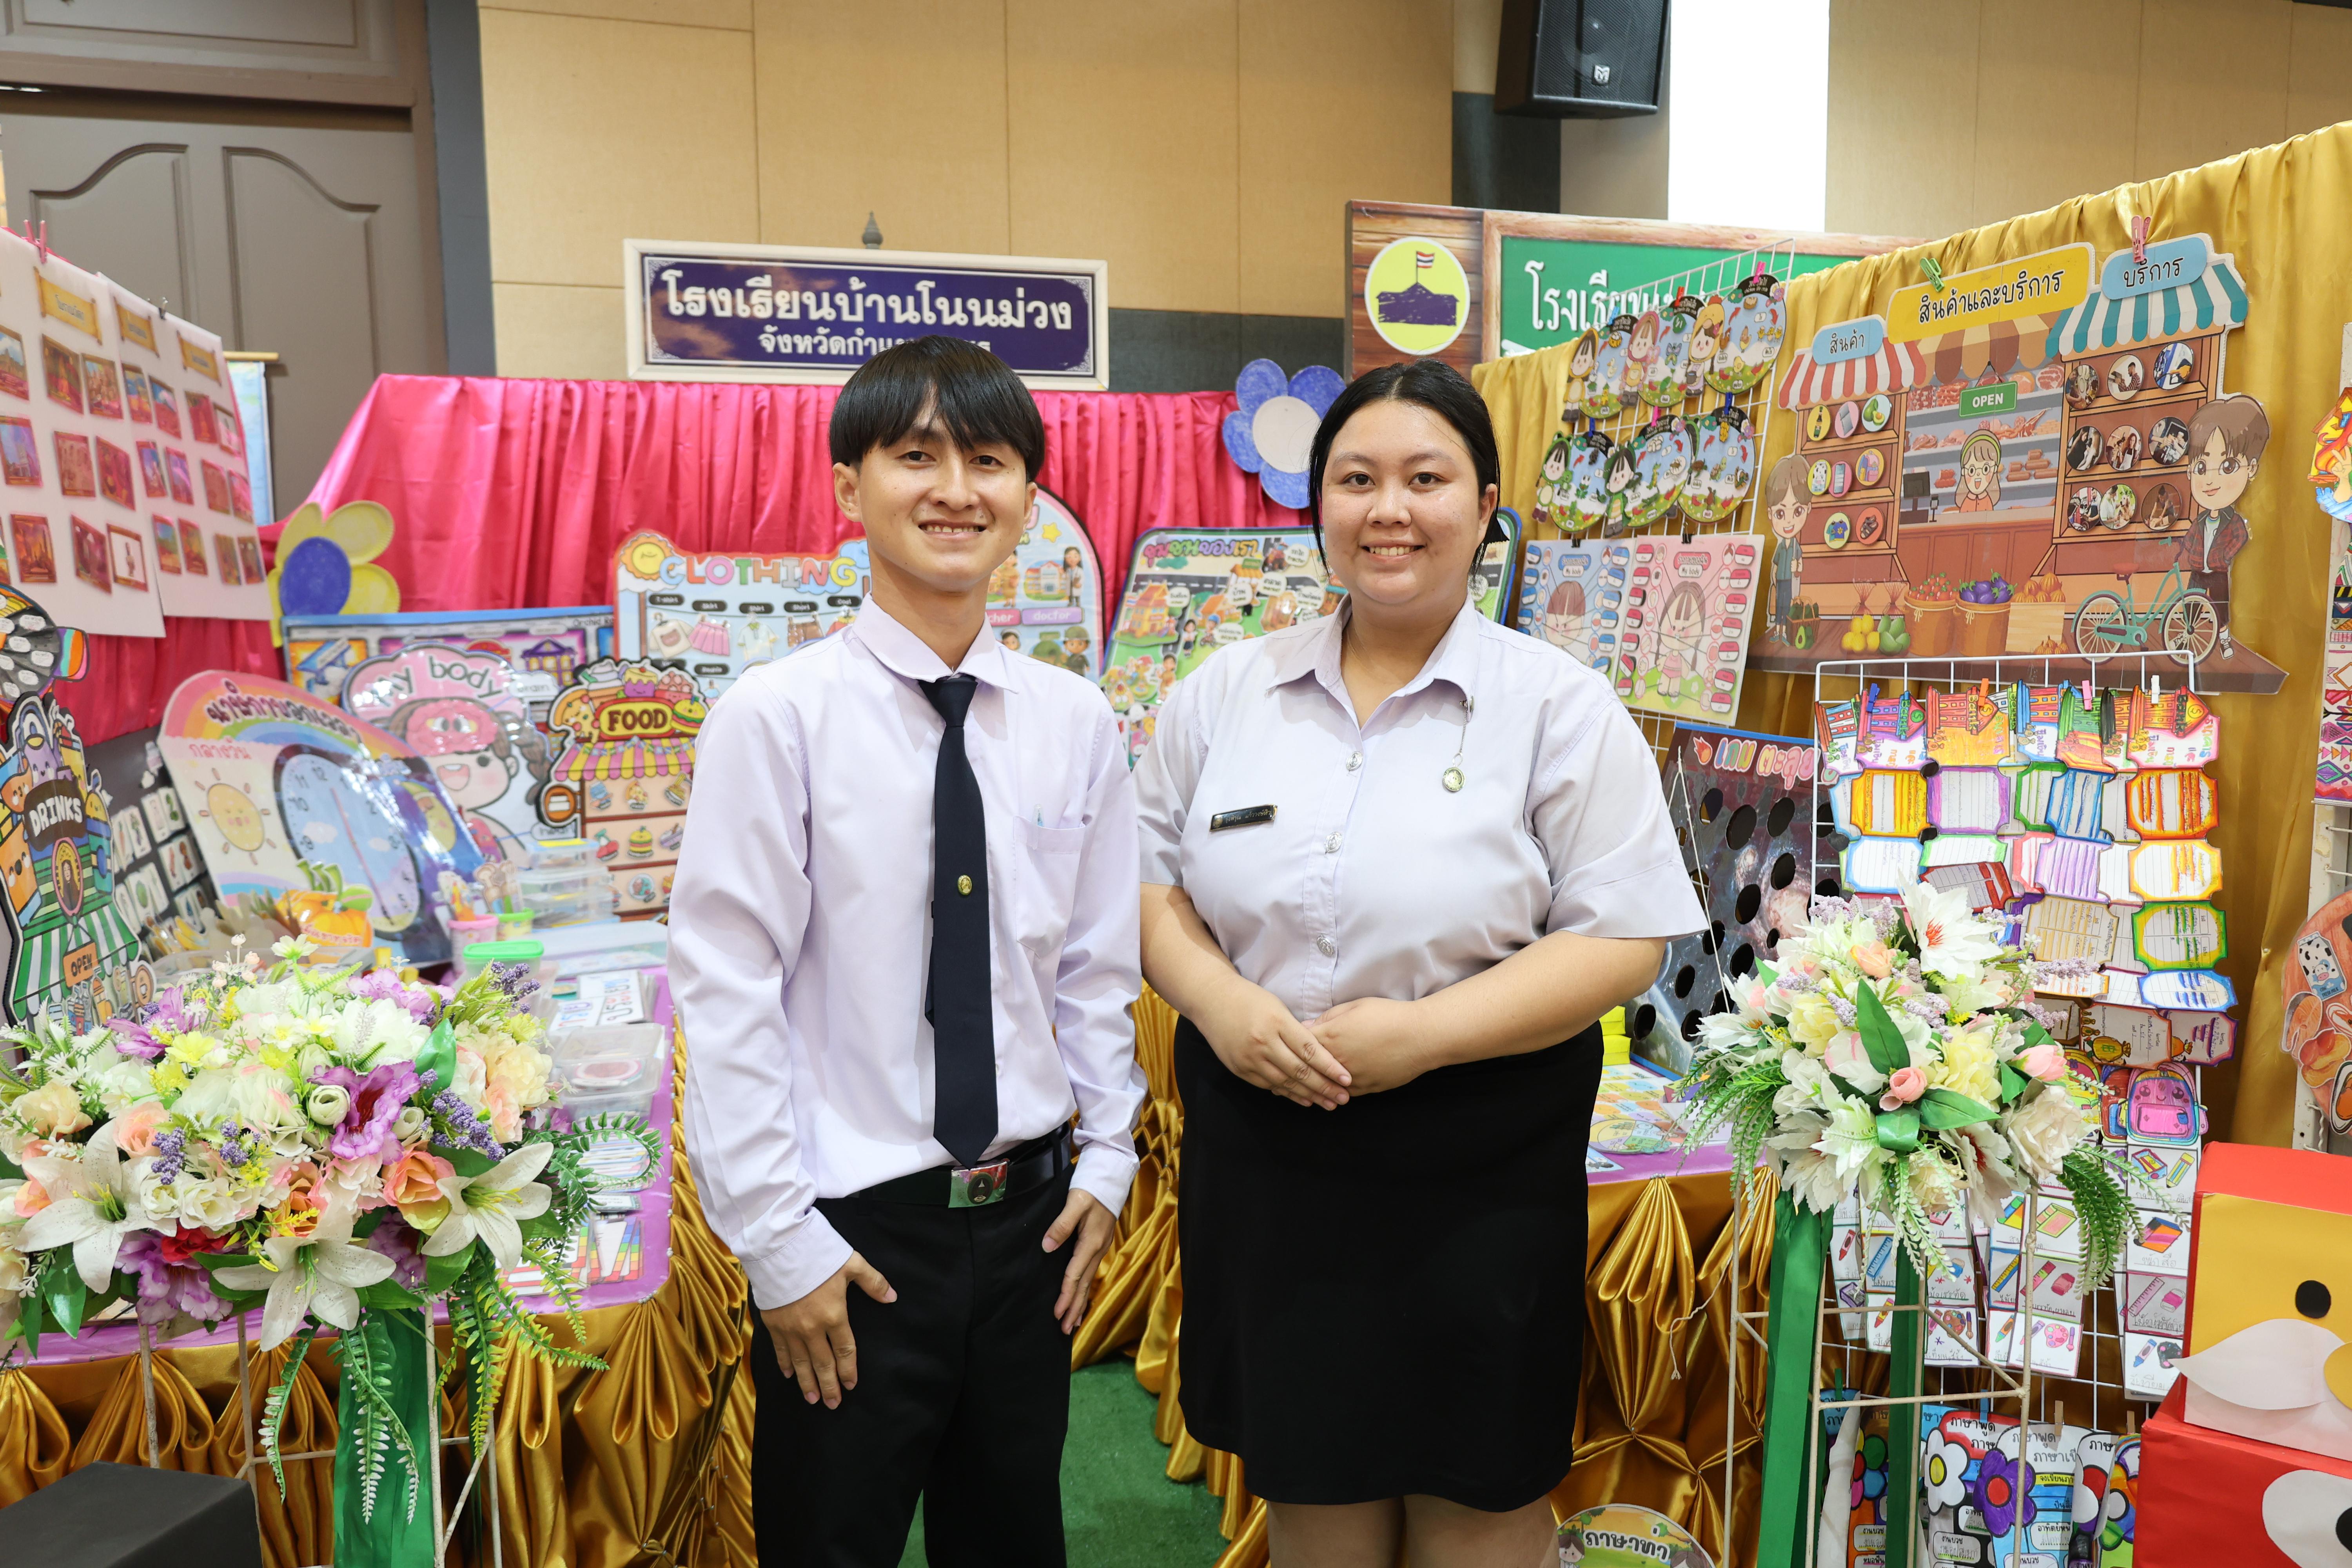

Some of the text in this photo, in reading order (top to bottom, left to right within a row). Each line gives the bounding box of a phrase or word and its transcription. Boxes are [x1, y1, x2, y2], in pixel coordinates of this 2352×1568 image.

[2123, 257, 2181, 290] บริการ
[661, 269, 1073, 331] โรงเรียนบ้านโนนม่วง
[1918, 269, 2064, 324] สินค้าและบริการ
[1829, 332, 1865, 355] สินค้า
[1971, 393, 2004, 409] OPEN
[1144, 539, 1258, 568] ชุมชนของเรา
[660, 556, 857, 588] CLOTHING
[1682, 566, 1699, 576] My body
[989, 610, 1072, 623] cher doctor
[428, 655, 504, 699] body
[606, 709, 668, 732] FOOD
[1899, 699, 1910, 736] Bank
[1968, 694, 1978, 730] Bank
[2176, 694, 2187, 732] Bank
[188, 735, 252, 759] กลางวัน
[2147, 735, 2159, 763] ยืมเงิน
[2200, 719, 2214, 758] ธนาคาร
[1715, 738, 1757, 771] เกม
[29, 795, 83, 838] DRINKS
[69, 952, 93, 976] OPEN
[1928, 1286, 1967, 1301] ม้บรรทัด
[1951, 1416, 1996, 1437] ภาษาพูด
[1942, 1535, 1964, 1544] งานบวช
